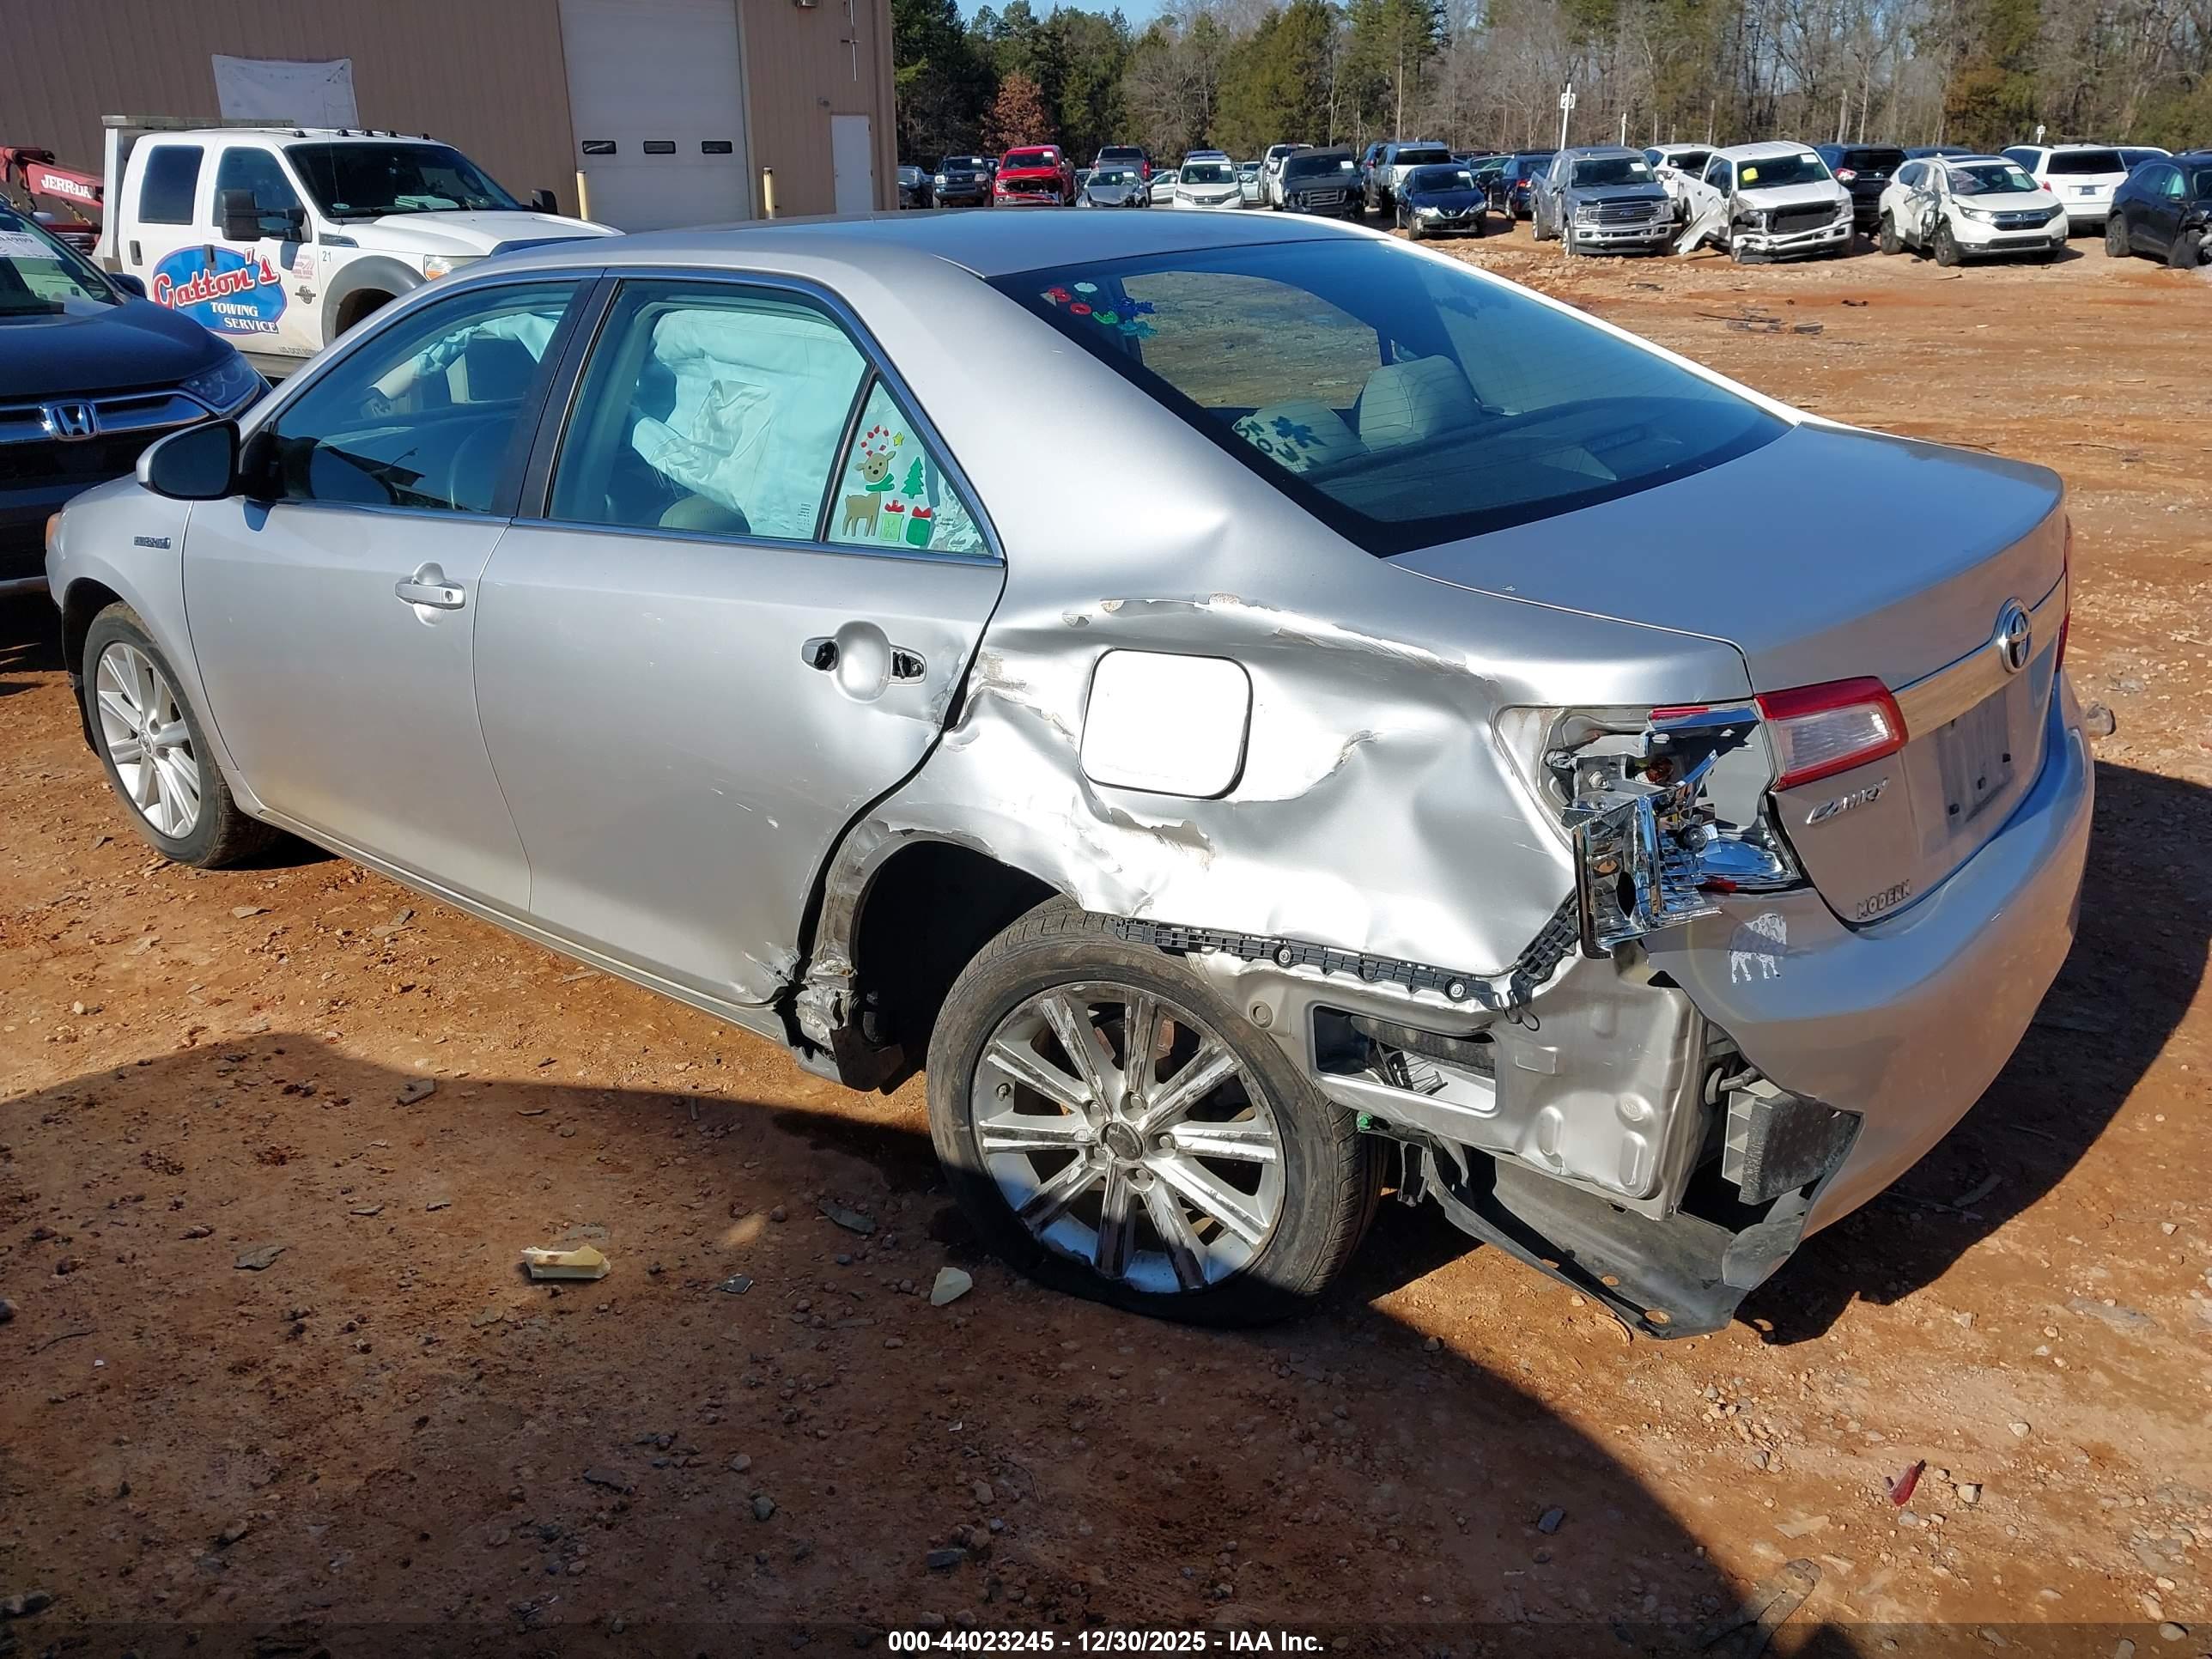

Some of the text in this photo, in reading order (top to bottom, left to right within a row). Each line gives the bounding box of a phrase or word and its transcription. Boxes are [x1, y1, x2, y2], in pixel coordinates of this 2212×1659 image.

[40, 173, 95, 200] JERR-DA
[322, 251, 331, 262] 21
[153, 247, 281, 311] Gatton's
[210, 301, 258, 317] TOWING
[223, 317, 279, 334] SERVICE
[1856, 878, 1910, 920] MODERN
